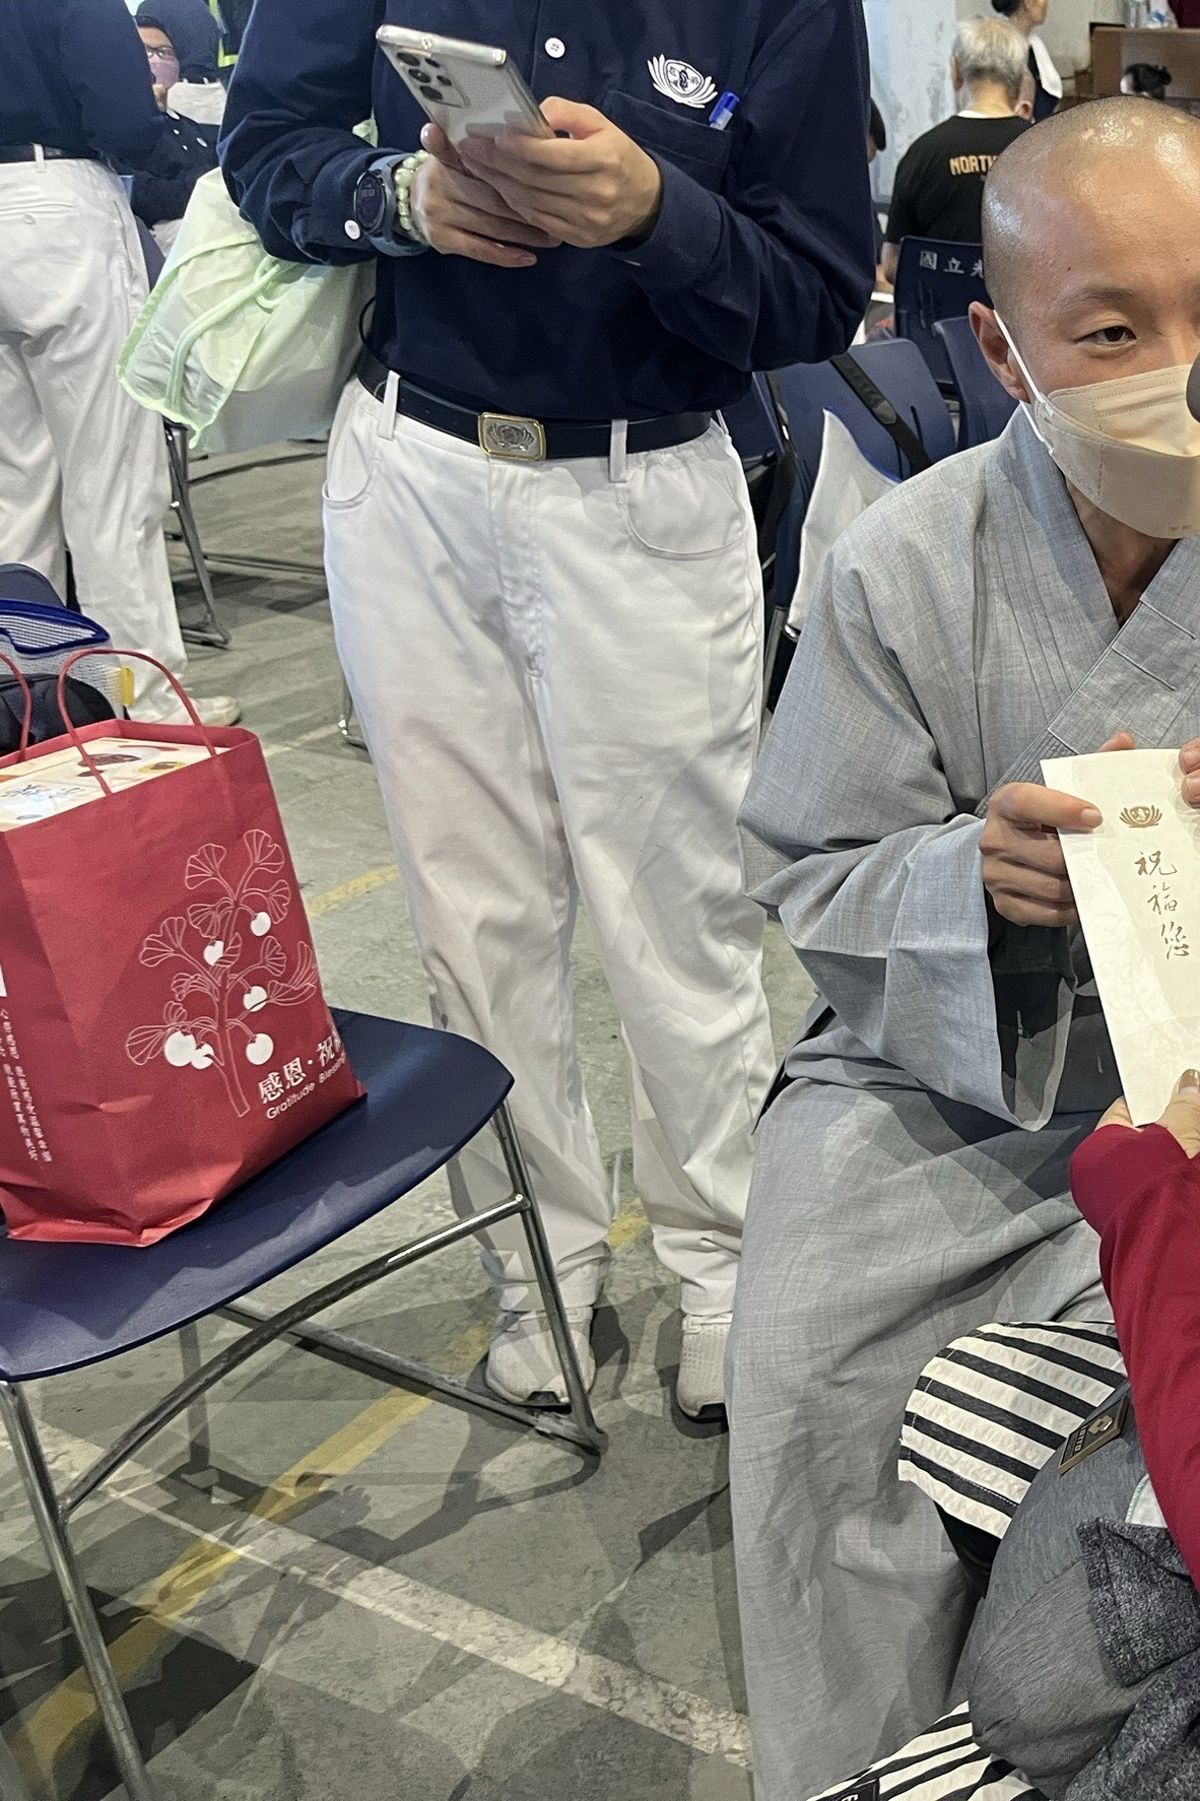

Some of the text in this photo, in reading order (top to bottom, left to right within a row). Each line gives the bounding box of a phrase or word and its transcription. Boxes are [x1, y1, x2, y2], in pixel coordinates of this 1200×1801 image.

[1133, 850, 1190, 960] 祝福您
[266, 1082, 315, 1119] Gratitude
